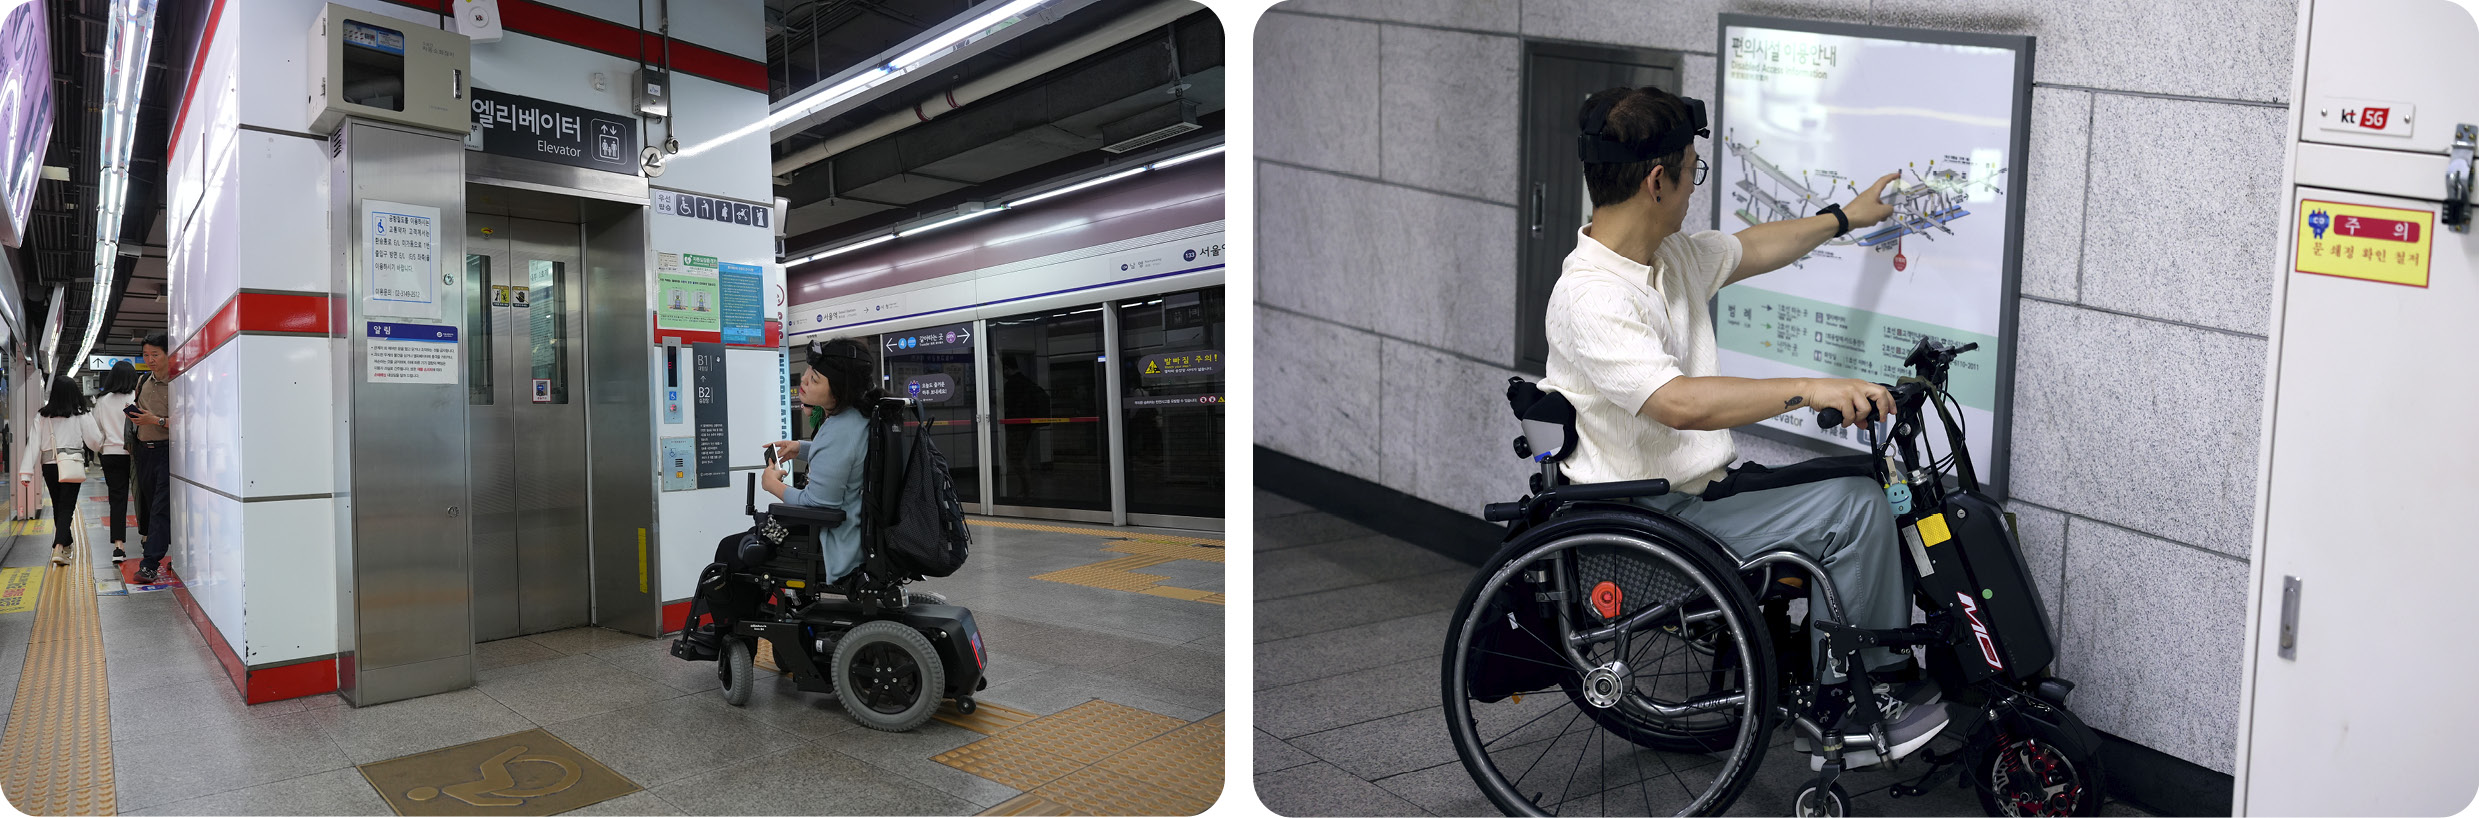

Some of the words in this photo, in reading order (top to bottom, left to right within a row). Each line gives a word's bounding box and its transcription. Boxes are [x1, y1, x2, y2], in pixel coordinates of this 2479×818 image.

[1731, 37, 1780, 62] 편의시설
[1784, 42, 1837, 68] 이용안내
[1731, 60, 1760, 72] Disabled
[1761, 64, 1783, 74] Access
[471, 98, 581, 142] 엘리베이터
[2341, 109, 2356, 124] kt
[2365, 110, 2384, 126] 5G
[537, 139, 582, 157] Elevator
[658, 194, 671, 203] 우선
[658, 203, 672, 212] 탑승
[2345, 217, 2361, 235] 주
[2393, 222, 2409, 241] 의
[2312, 242, 2324, 256] 문
[2362, 247, 2387, 263] 확인
[2394, 250, 2420, 267] 철저
[824, 312, 838, 321] 서울역
[1728, 305, 1736, 318] 범
[1744, 308, 1752, 320] 례
[374, 325, 381, 335] 알
[383, 326, 391, 335] 림
[1883, 326, 1896, 335] 1호선
[919, 334, 937, 343] 갈아타는
[938, 333, 944, 341] 곳
[1882, 344, 1895, 353] 2호선
[697, 355, 708, 366] B1
[1164, 355, 1189, 366] 발빠짐
[1195, 353, 1218, 363] 주의!
[1884, 365, 1896, 373] 2호선
[698, 386, 710, 398] B2
